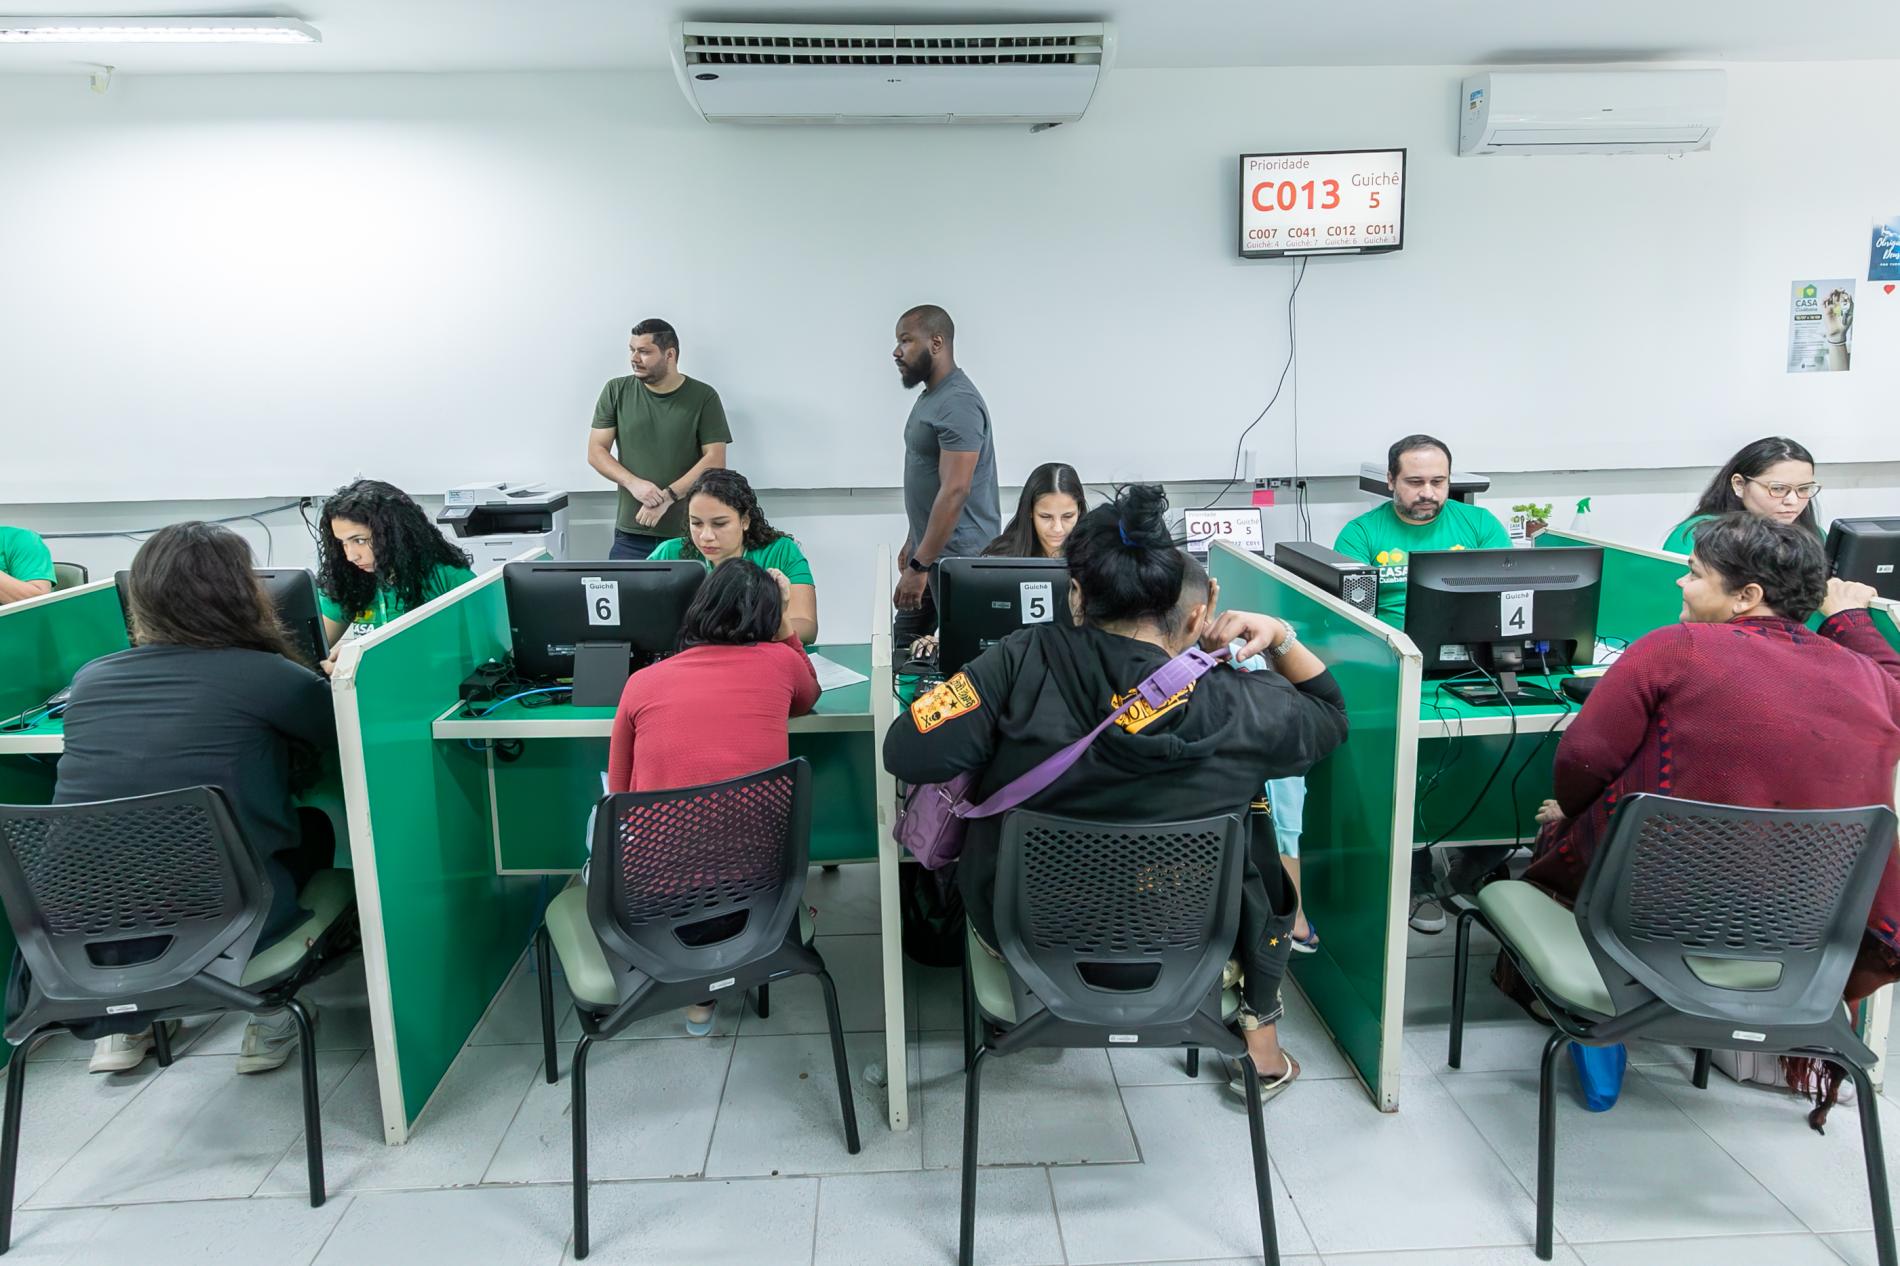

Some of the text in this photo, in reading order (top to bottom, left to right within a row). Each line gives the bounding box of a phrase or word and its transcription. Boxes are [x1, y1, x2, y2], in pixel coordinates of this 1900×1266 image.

[1250, 158, 1310, 171] Prioridade
[1351, 171, 1400, 187] Guichê
[1251, 179, 1341, 212] C013
[1368, 191, 1381, 209] 5
[1248, 224, 1395, 240] C007 C041 C012 C011
[1795, 299, 1818, 307] CASA
[1190, 521, 1233, 535] C013
[1246, 527, 1252, 535] 5
[1505, 592, 1530, 600] Guichê
[595, 597, 612, 621] 6
[1029, 597, 1046, 619] 5
[1508, 606, 1526, 630] 4
[353, 623, 375, 634] ASA
